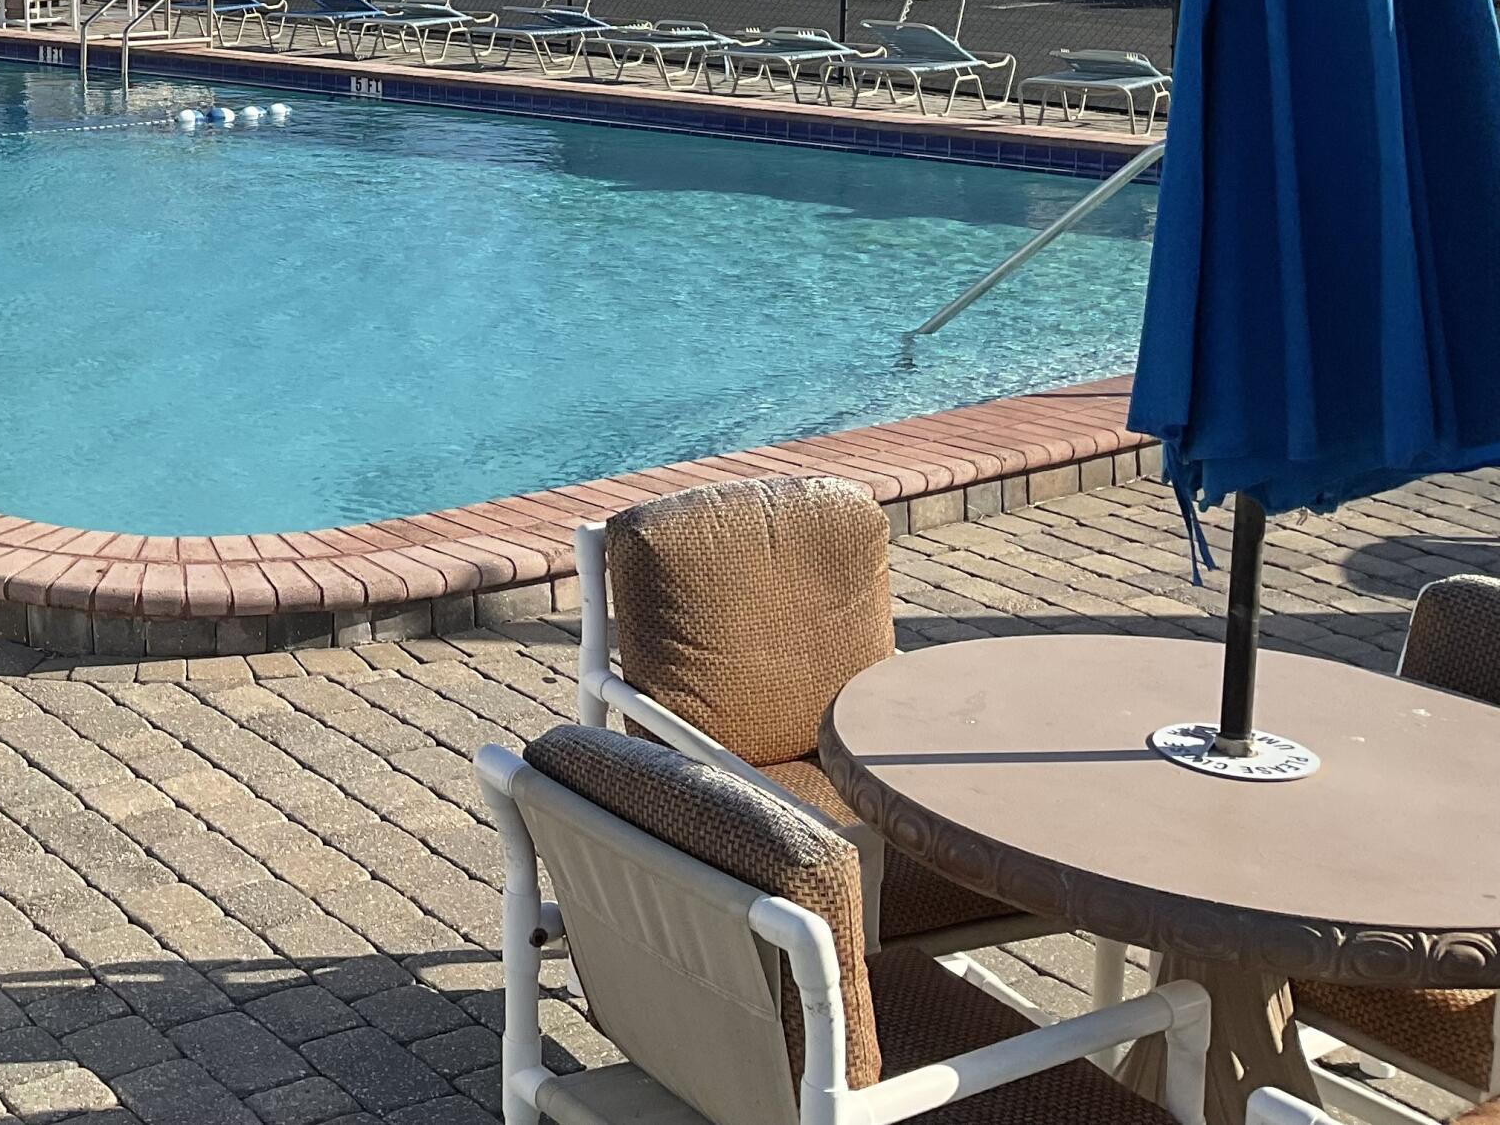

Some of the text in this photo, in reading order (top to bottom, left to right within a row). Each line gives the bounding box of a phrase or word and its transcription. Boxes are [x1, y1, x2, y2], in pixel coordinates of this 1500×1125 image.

[356, 77, 381, 93] 5 FT
[1240, 756, 1309, 774] PLEASE
